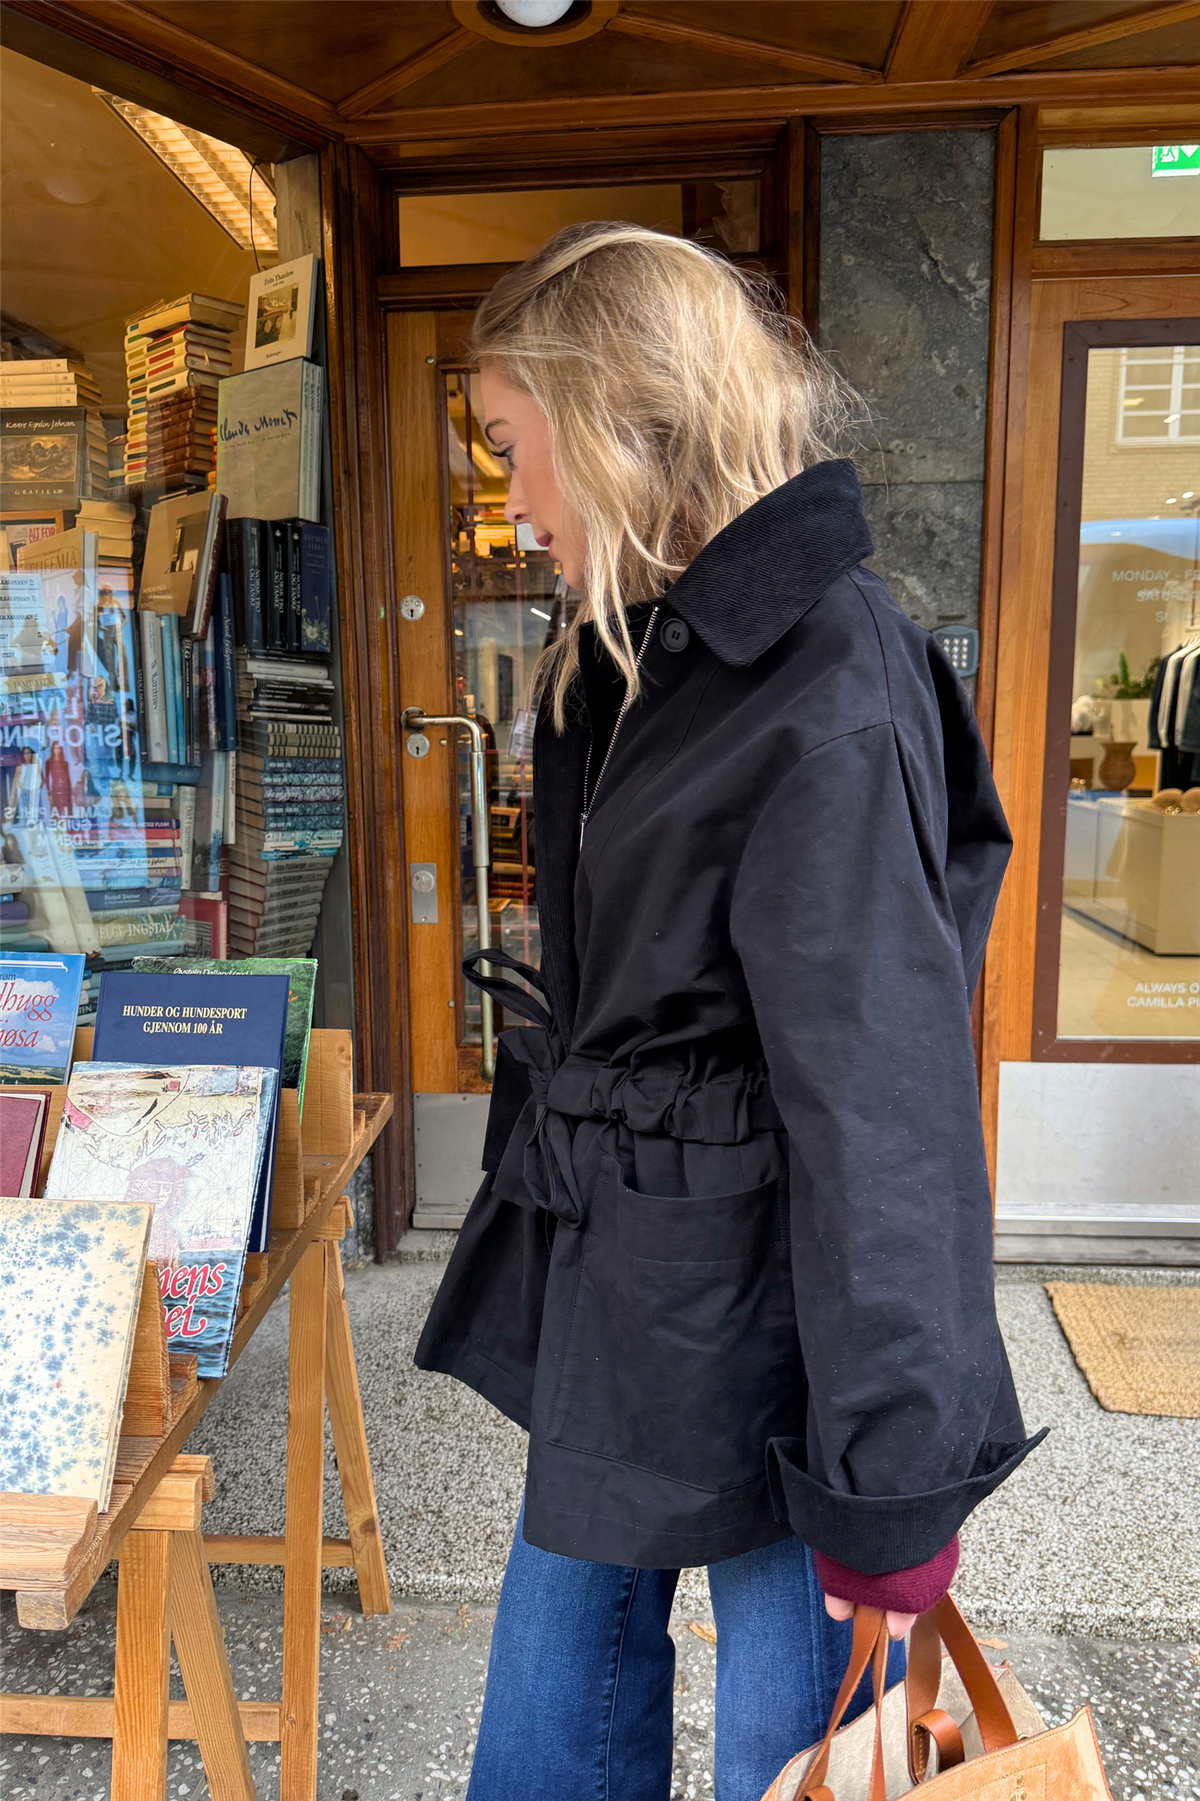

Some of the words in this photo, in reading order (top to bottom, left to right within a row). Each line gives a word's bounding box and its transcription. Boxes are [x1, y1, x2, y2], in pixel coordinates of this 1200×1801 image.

[1112, 570, 1171, 582] MONDAY
[185, 805, 194, 820] Dikt
[184, 826, 193, 854] samling
[122, 892, 141, 900] Steiner
[97, 923, 126, 939] ELGE
[1134, 982, 1187, 995] ALWAYS
[1126, 996, 1186, 1009] CAMILLA
[123, 1005, 163, 1018] HUNDER
[165, 1006, 180, 1018] OG
[182, 1006, 247, 1020] HUNDESPORT
[143, 1021, 191, 1034] GJENNOM
[193, 1022, 208, 1034] 100
[209, 1021, 223, 1035] ÅR
[163, 1294, 208, 1338] ei
